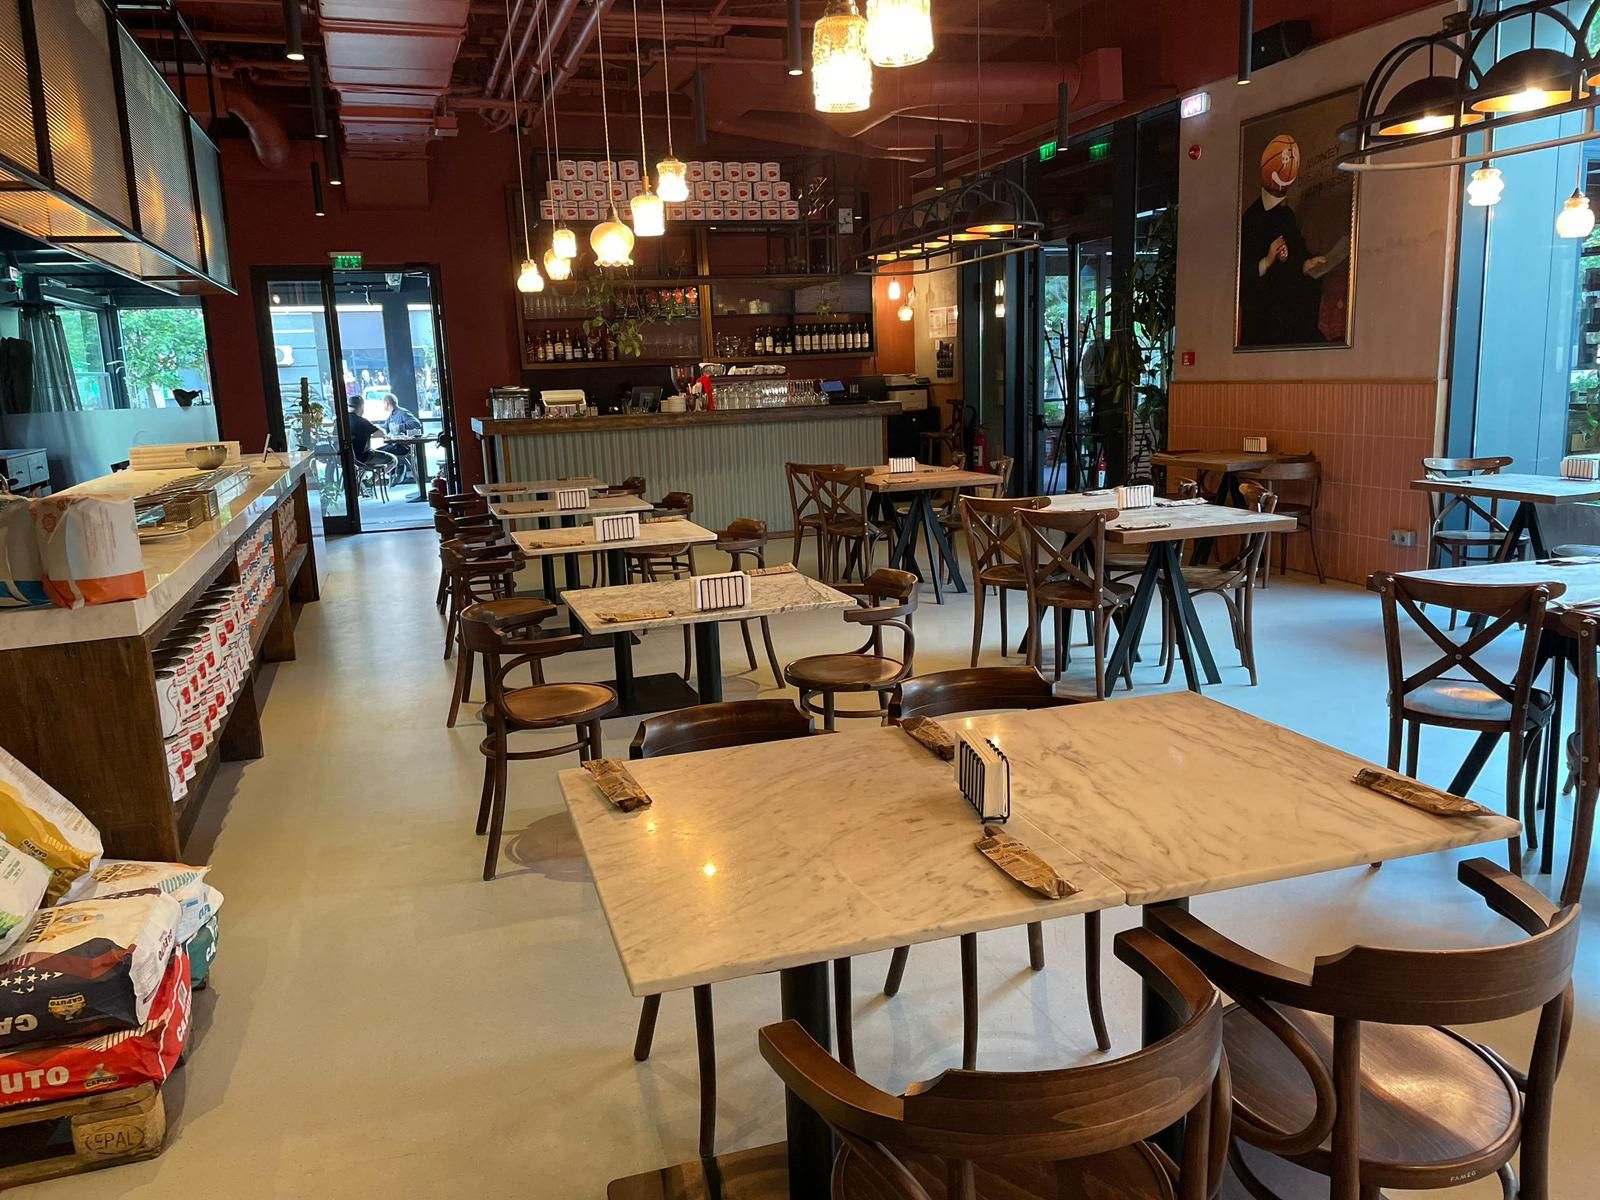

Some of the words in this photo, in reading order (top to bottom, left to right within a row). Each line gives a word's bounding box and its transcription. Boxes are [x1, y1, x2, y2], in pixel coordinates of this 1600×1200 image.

[23, 839, 48, 858] CAPUTO
[26, 911, 54, 943] CAPUTO
[50, 995, 84, 1007] CAPUTO
[86, 1075, 118, 1088] CAPUTO
